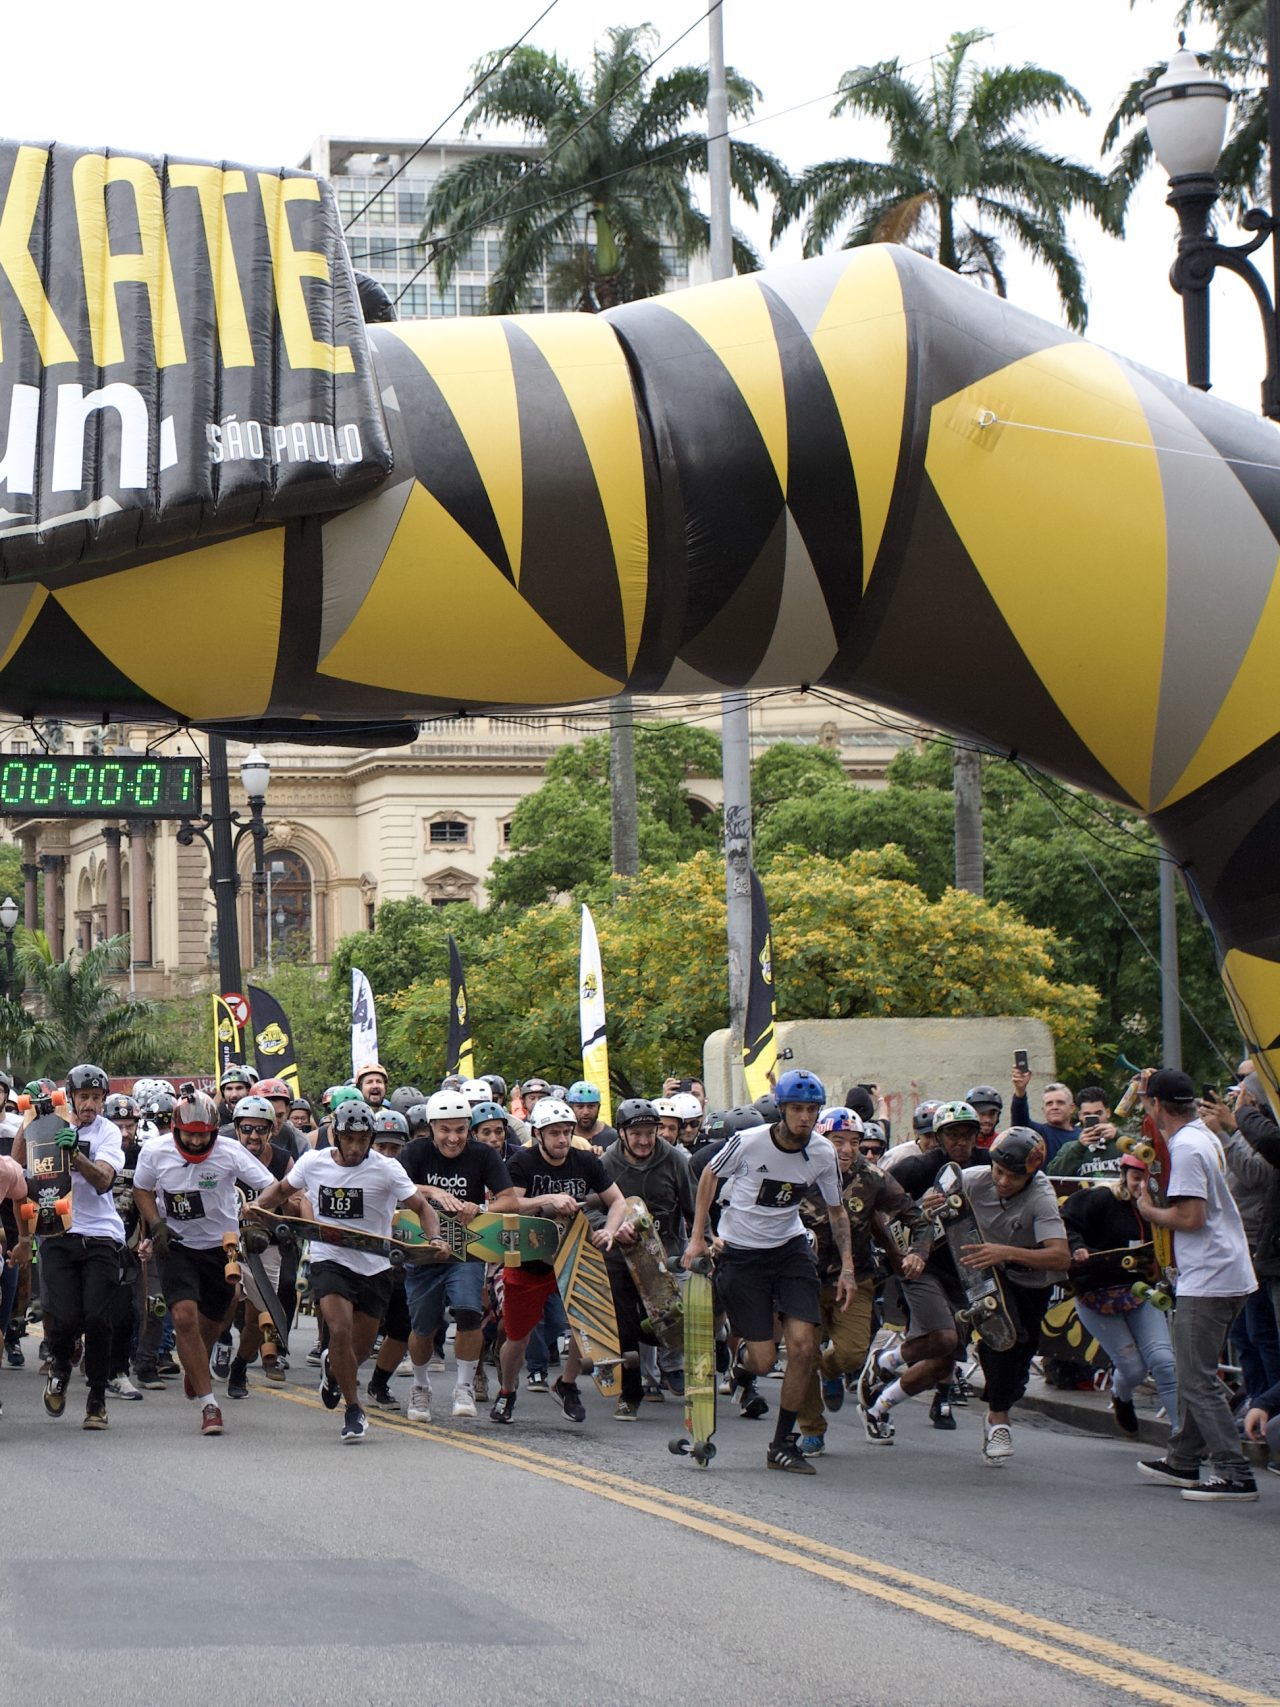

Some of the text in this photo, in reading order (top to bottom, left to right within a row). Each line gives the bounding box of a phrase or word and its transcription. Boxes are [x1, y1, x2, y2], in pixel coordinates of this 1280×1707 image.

[206, 414, 364, 465] SÃO PAULO
[1, 763, 191, 805] 00:00:01
[426, 1173, 468, 1187] virada
[775, 1190, 793, 1202] 46
[172, 1201, 192, 1214] 104
[330, 1197, 352, 1211] 163
